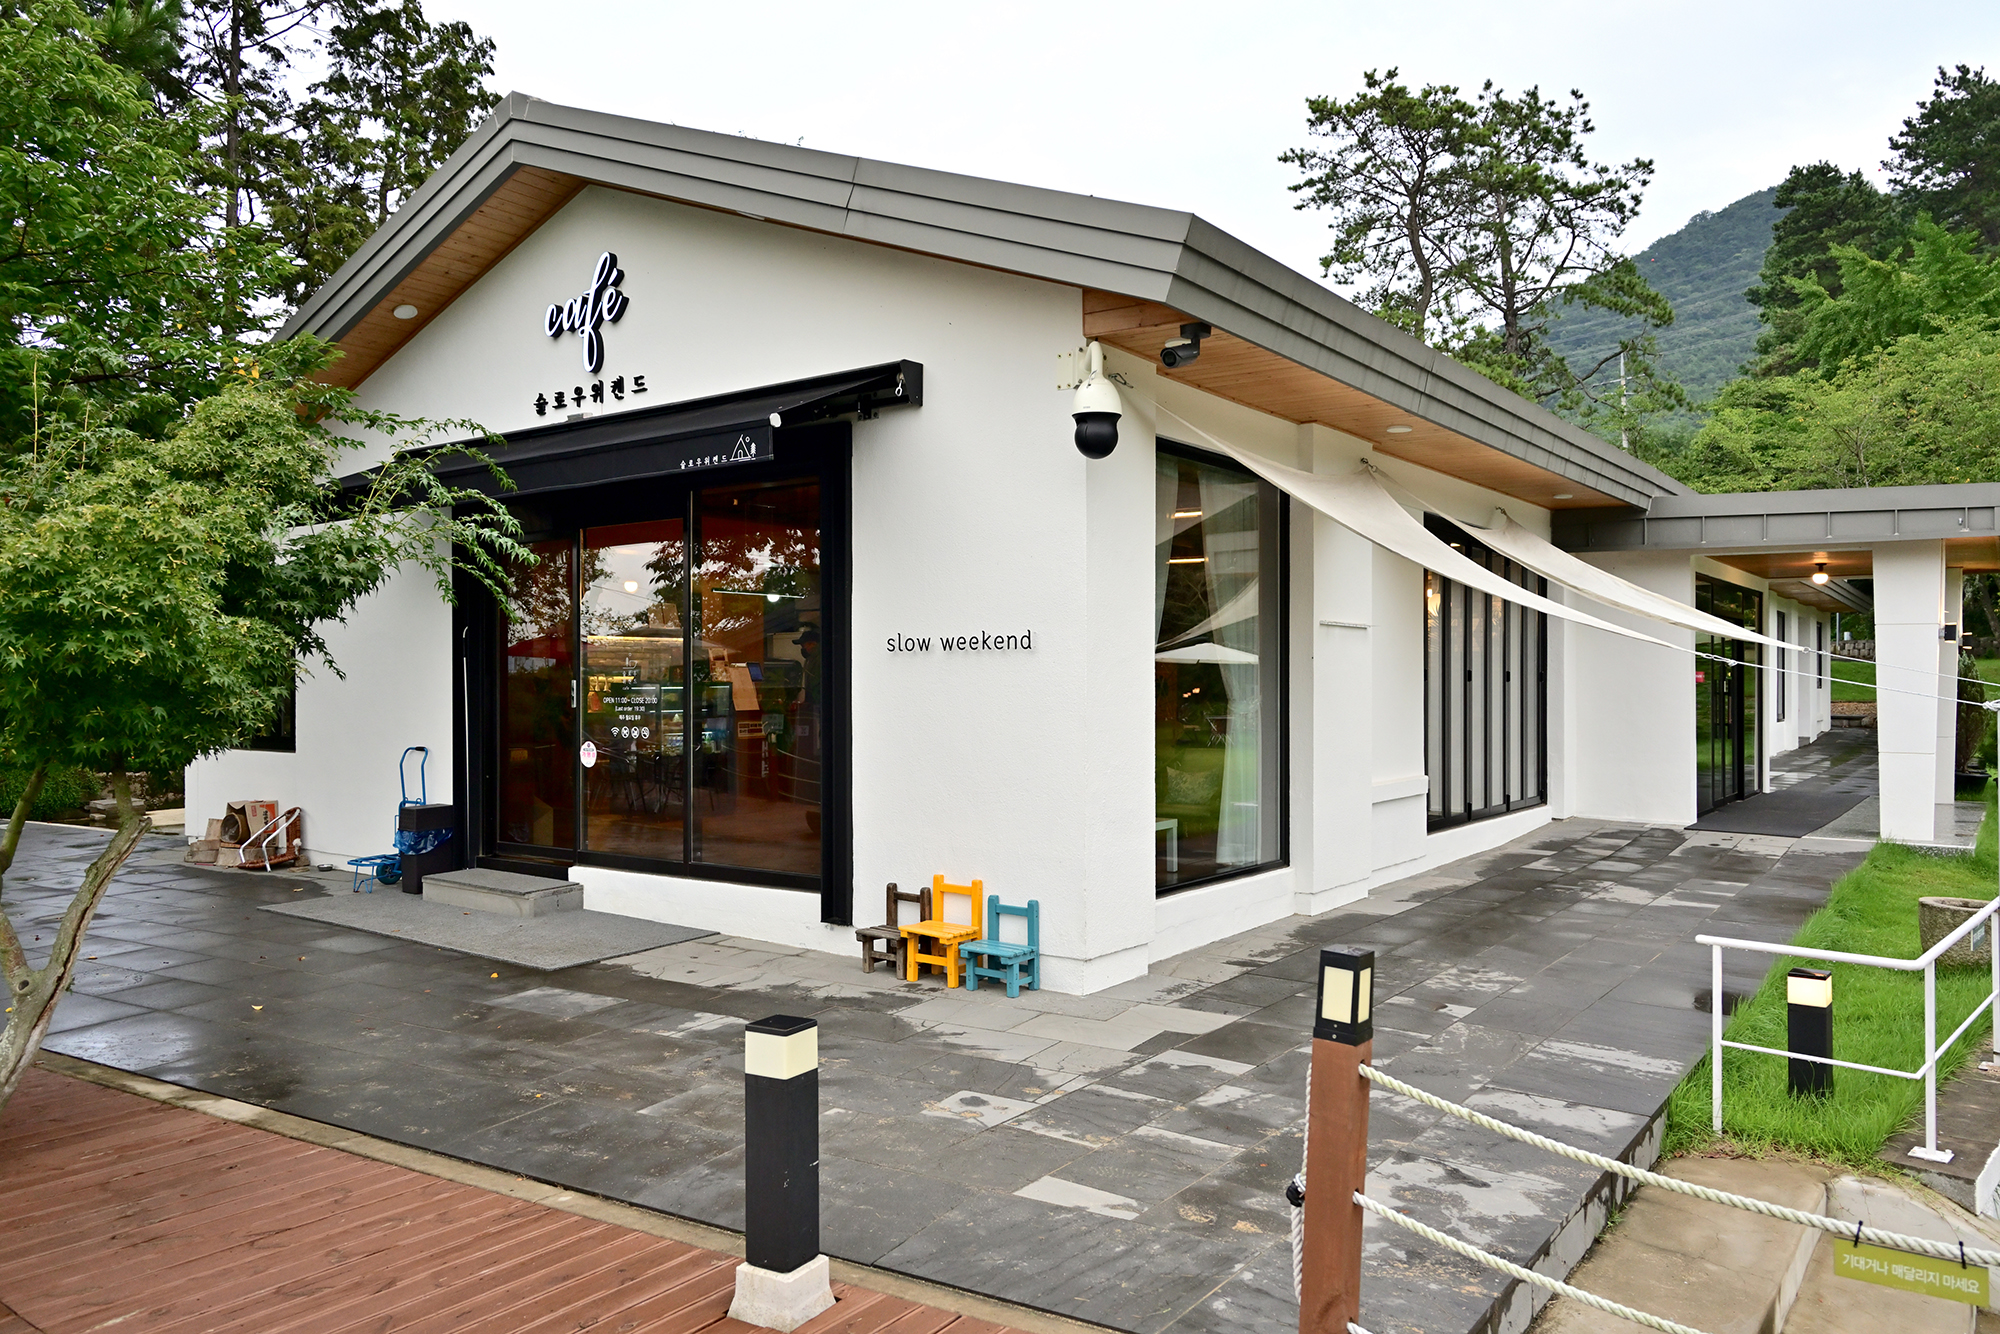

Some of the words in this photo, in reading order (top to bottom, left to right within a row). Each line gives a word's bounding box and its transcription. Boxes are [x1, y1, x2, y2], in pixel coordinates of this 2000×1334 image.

[533, 375, 648, 416] 슬로우위켄드
[886, 632, 931, 652] slow
[939, 629, 1032, 652] weekend
[1842, 1253, 1888, 1276] 기대거나
[1891, 1264, 1940, 1287] 매달리지
[1942, 1275, 1981, 1295] 마세요
